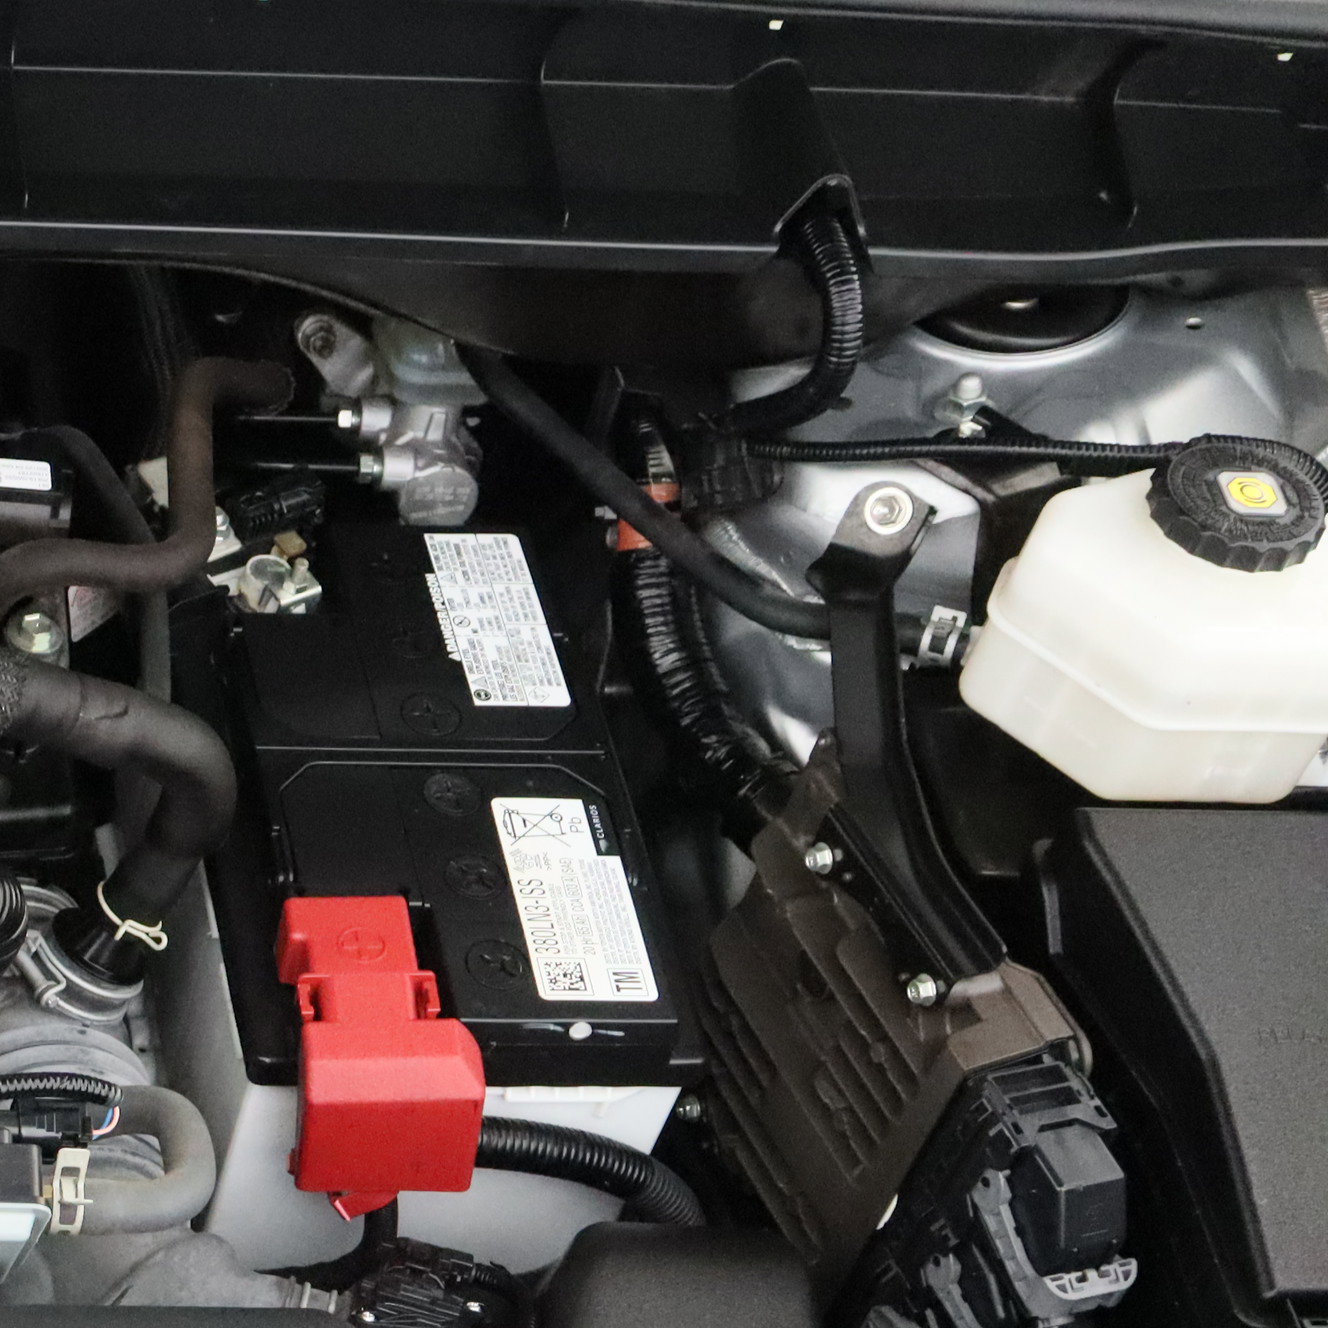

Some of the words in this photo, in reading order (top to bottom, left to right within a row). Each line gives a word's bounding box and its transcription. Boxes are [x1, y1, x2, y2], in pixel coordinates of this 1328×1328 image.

[569, 817, 584, 833] Pb
[589, 804, 604, 838] CLARIOS
[517, 878, 560, 954] 380LN3-ISS
[612, 970, 643, 992] TM
